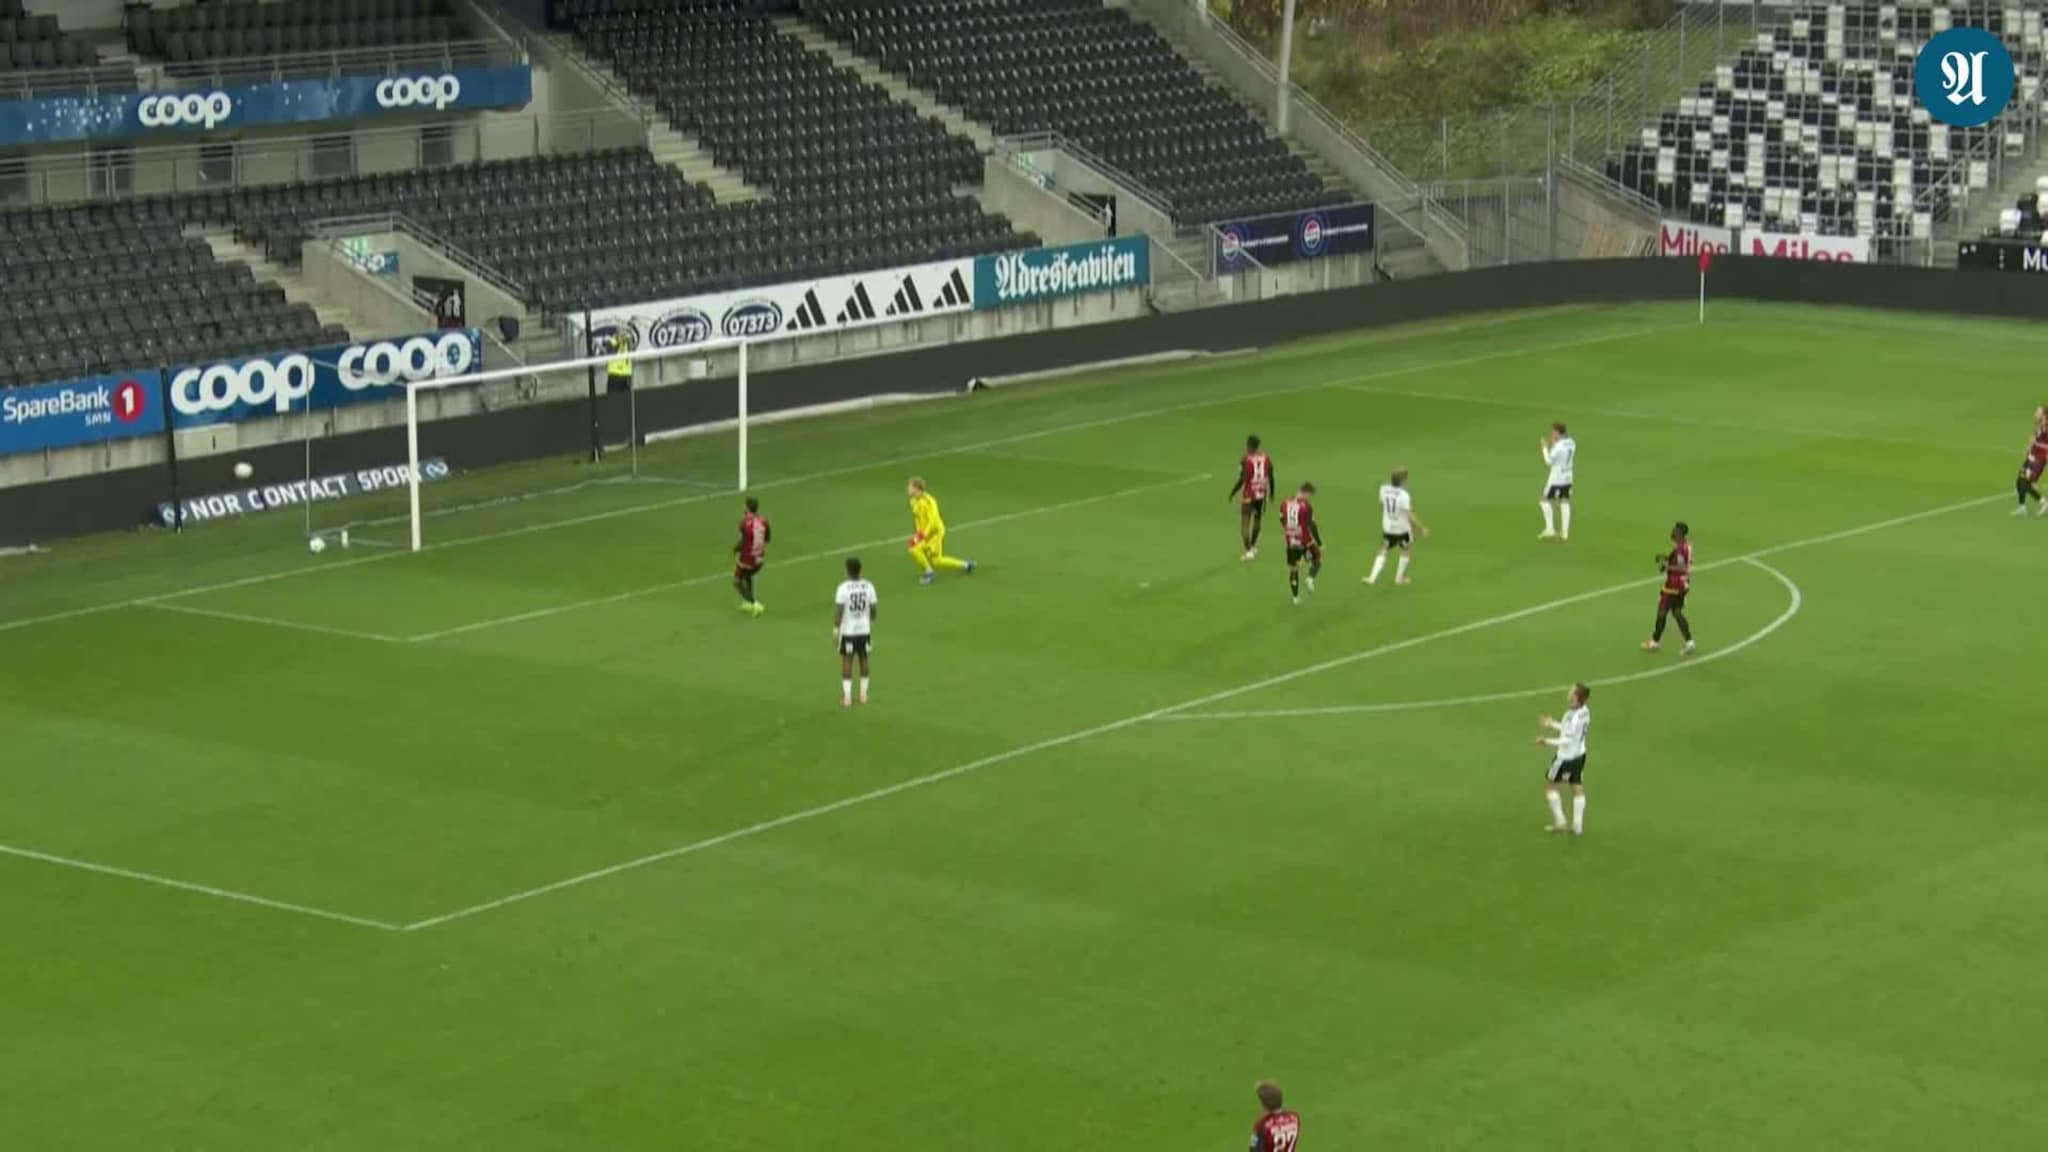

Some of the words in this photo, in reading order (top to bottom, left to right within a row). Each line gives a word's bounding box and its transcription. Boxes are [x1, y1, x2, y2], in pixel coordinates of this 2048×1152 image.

[138, 91, 231, 129] coop
[376, 74, 460, 110] coop
[658, 323, 705, 346] 07373
[729, 311, 775, 334] 07373
[338, 332, 472, 390] coop
[170, 354, 316, 415] coop
[3, 385, 110, 424] SpareBank
[121, 386, 135, 416] 1
[85, 411, 112, 427] SMN
[190, 494, 242, 521] NOR
[249, 475, 350, 511] CONTACT
